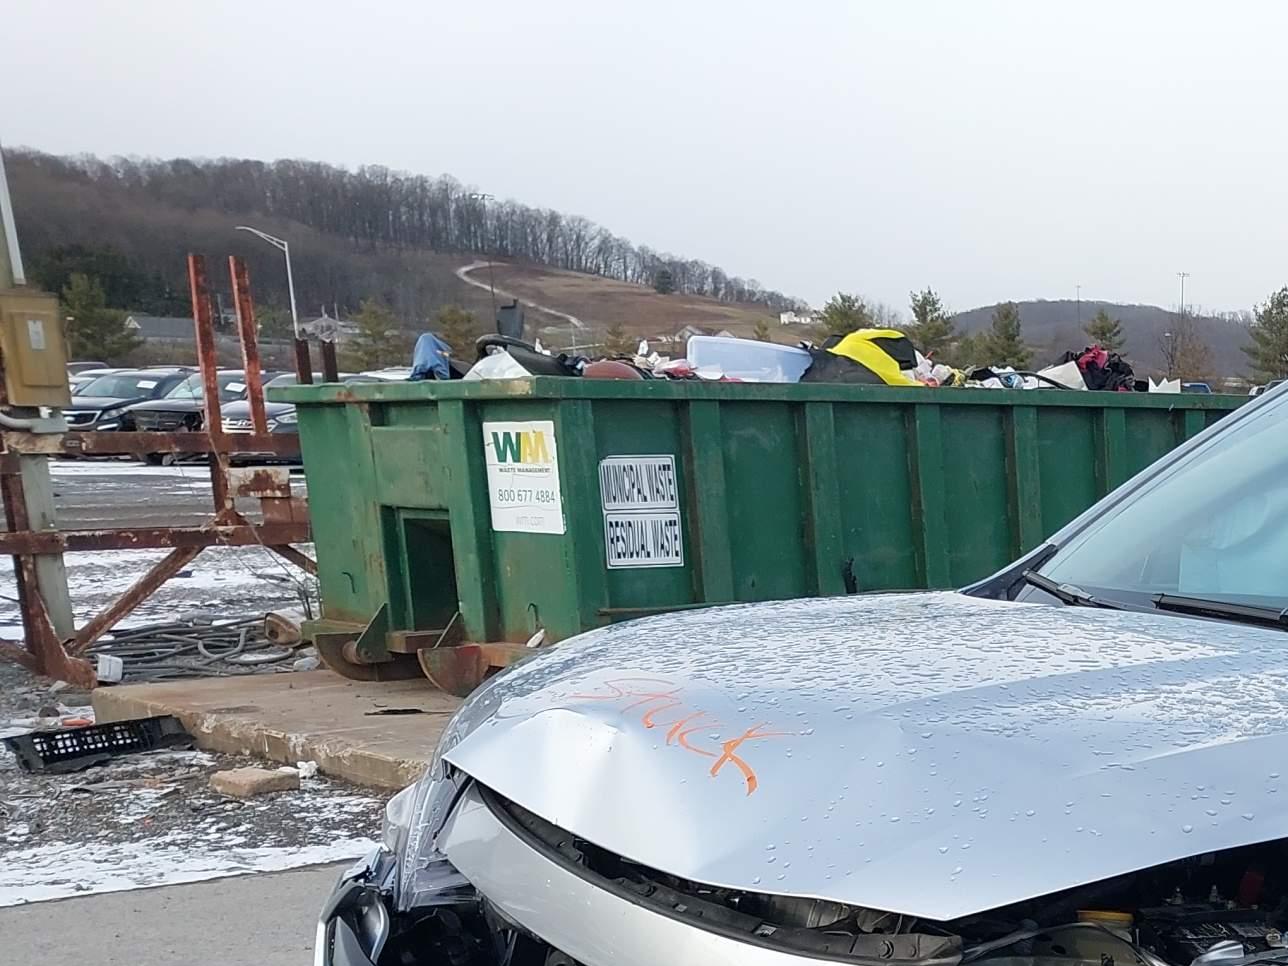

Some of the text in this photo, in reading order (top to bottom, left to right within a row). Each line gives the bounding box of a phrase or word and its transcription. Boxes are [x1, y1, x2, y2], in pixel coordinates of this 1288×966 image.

[491, 431, 551, 465] WM
[498, 489, 556, 503] 800 677 4884
[602, 464, 675, 503] MUNICIPAL WASTE
[608, 519, 680, 559] RESIDUAL WASTE
